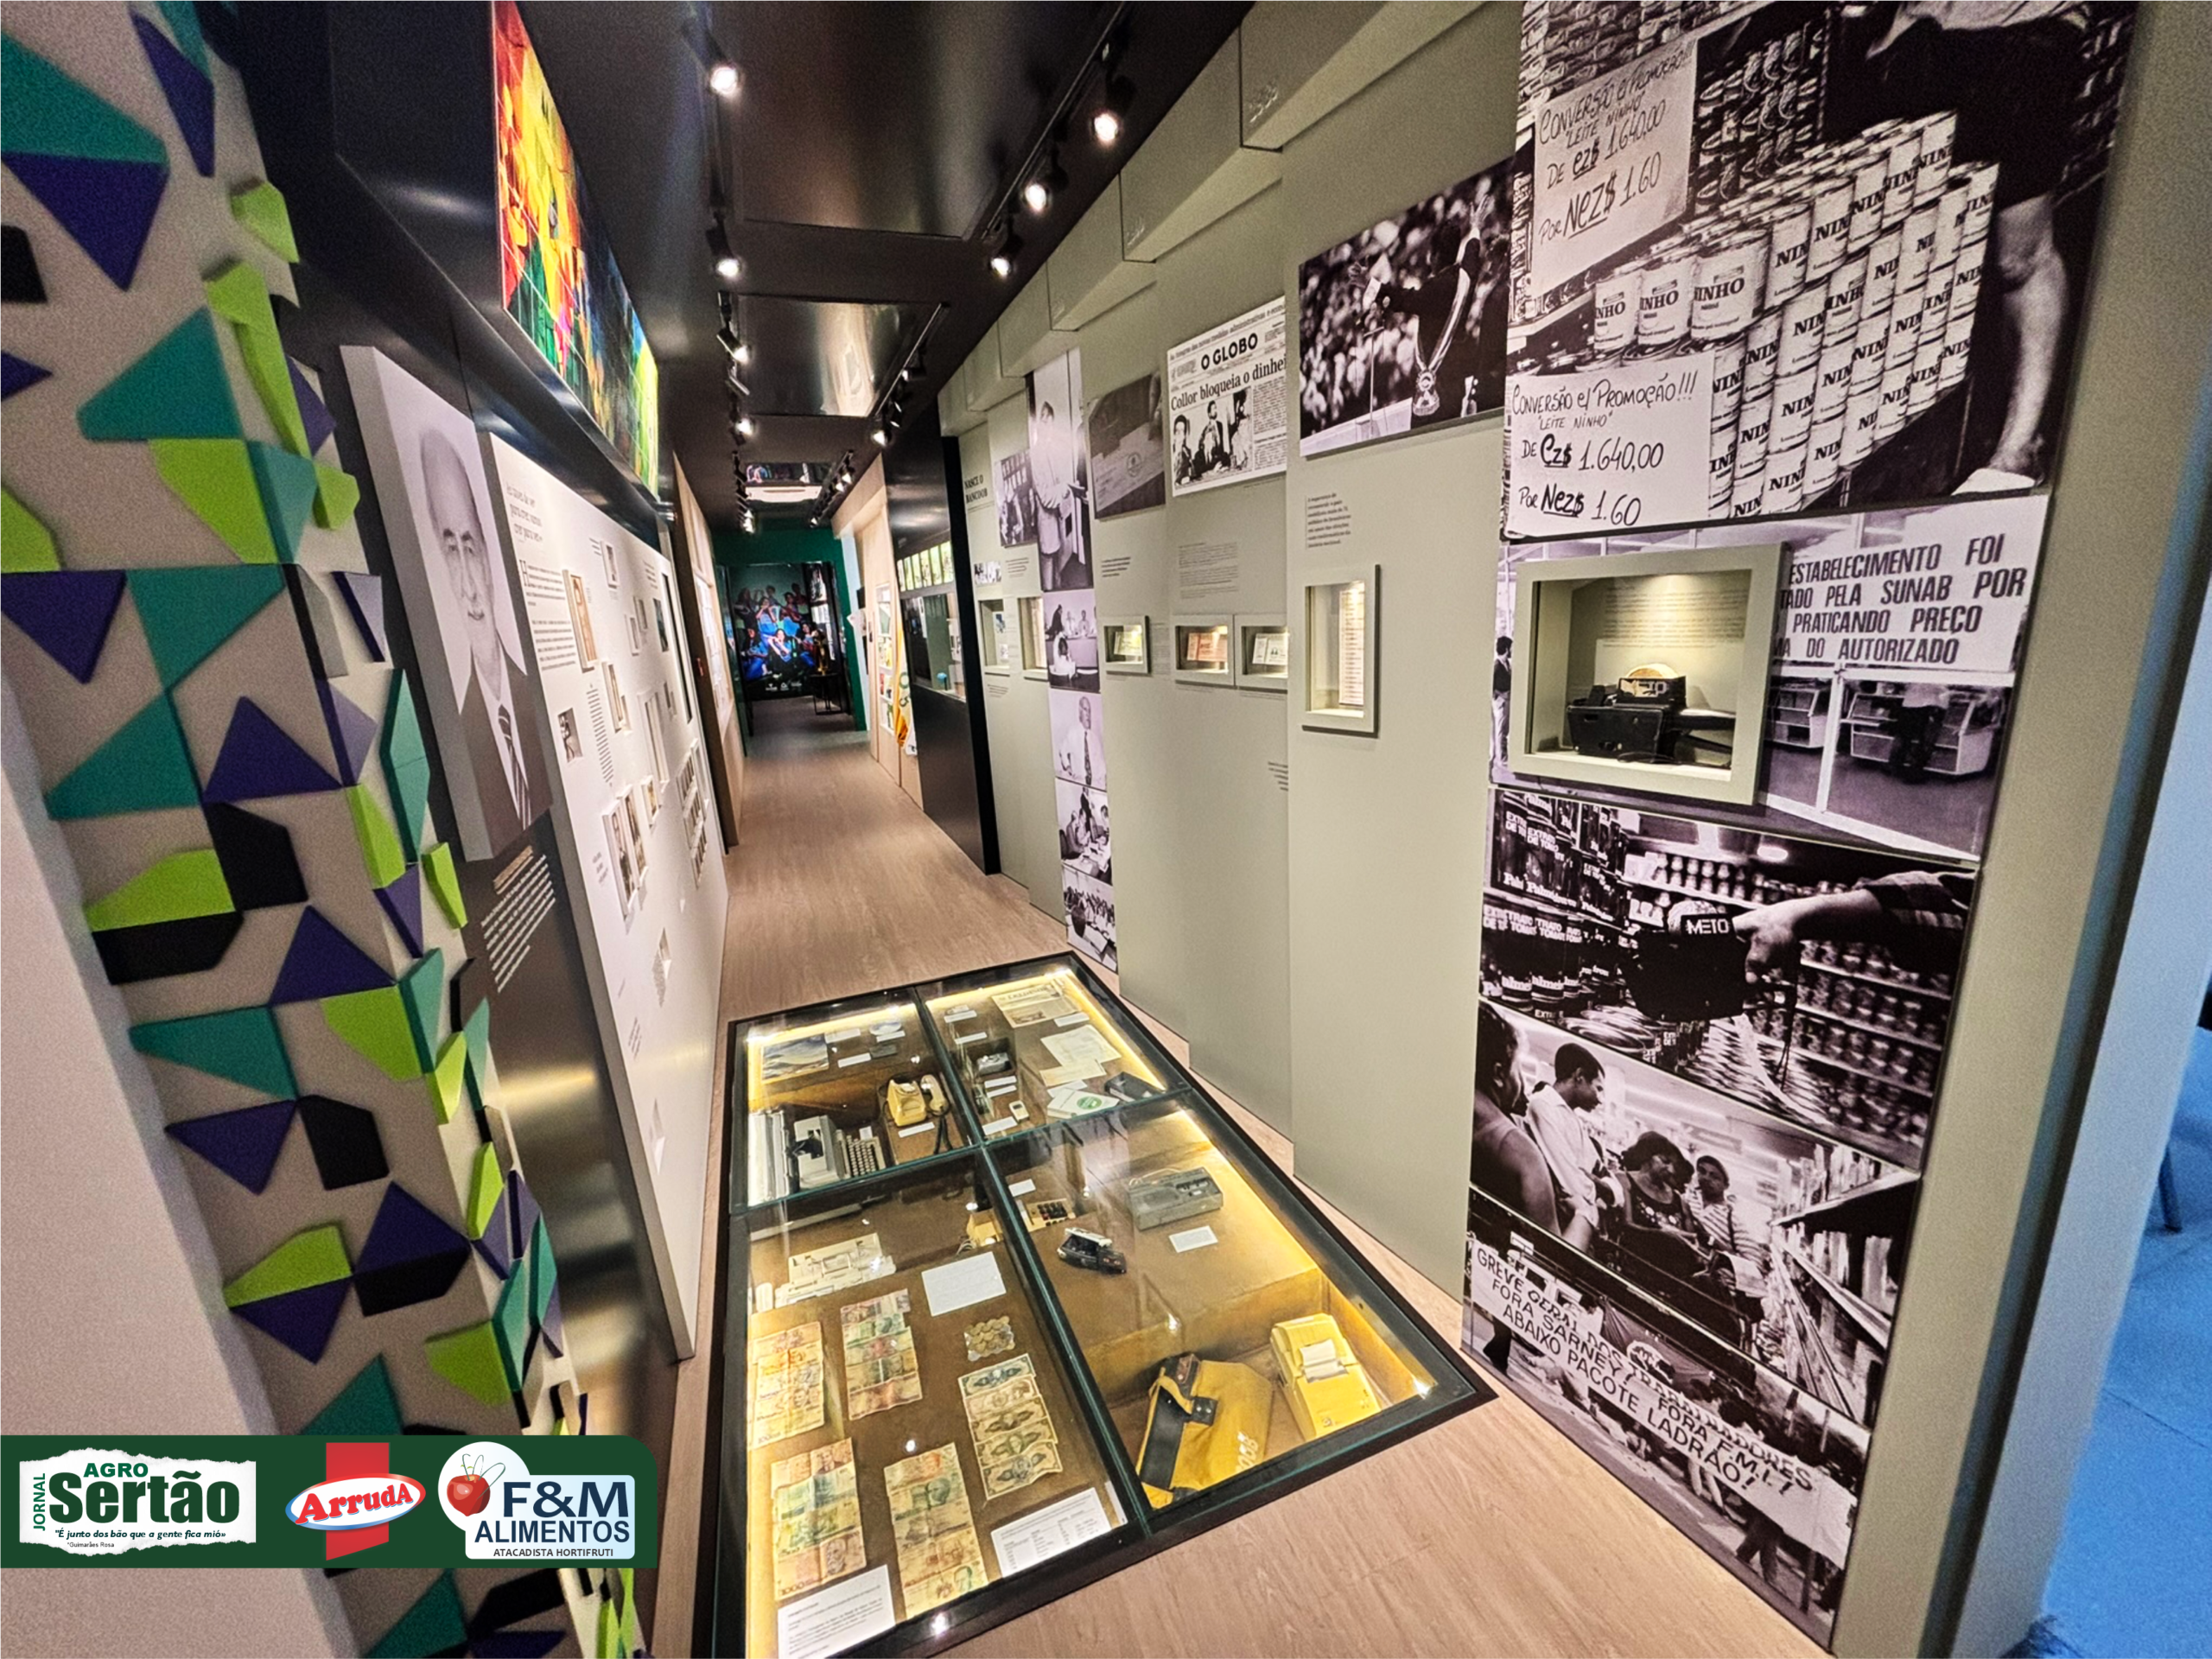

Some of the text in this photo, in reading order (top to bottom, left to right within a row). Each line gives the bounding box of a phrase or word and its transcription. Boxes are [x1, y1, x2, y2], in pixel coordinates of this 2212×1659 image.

[1547, 162, 1565, 189] DE
[1619, 151, 1661, 207] 1.60
[1200, 332, 1258, 371] O GLOBO
[1171, 391, 1198, 411] Collor
[1199, 373, 1241, 400] bloqueia
[1243, 372, 1249, 385] o
[1512, 384, 1573, 416] CONVERSÃO
[1522, 439, 1537, 460] DE
[1578, 435, 1664, 474] 1.640,00
[1591, 490, 1641, 527] 1.60
[1789, 533, 2005, 586] ESTABELECIMENTO FOI
[1825, 583, 1862, 607] PELA
[1879, 575, 1953, 605] SUNAB
[1973, 567, 2028, 600] POR
[1792, 605, 1983, 634] PRATICANDO PREÇO
[1806, 637, 1826, 658] DO
[1838, 639, 1960, 664] AUTORIZADO
[1686, 918, 1730, 934] METO
[1477, 1248, 1524, 1294] GREVE
[1492, 1278, 1535, 1319] FORA
[1657, 1397, 1708, 1442] FORA
[1503, 1304, 1561, 1356] ABAIXO
[1567, 1349, 1640, 1414] PACOTE
